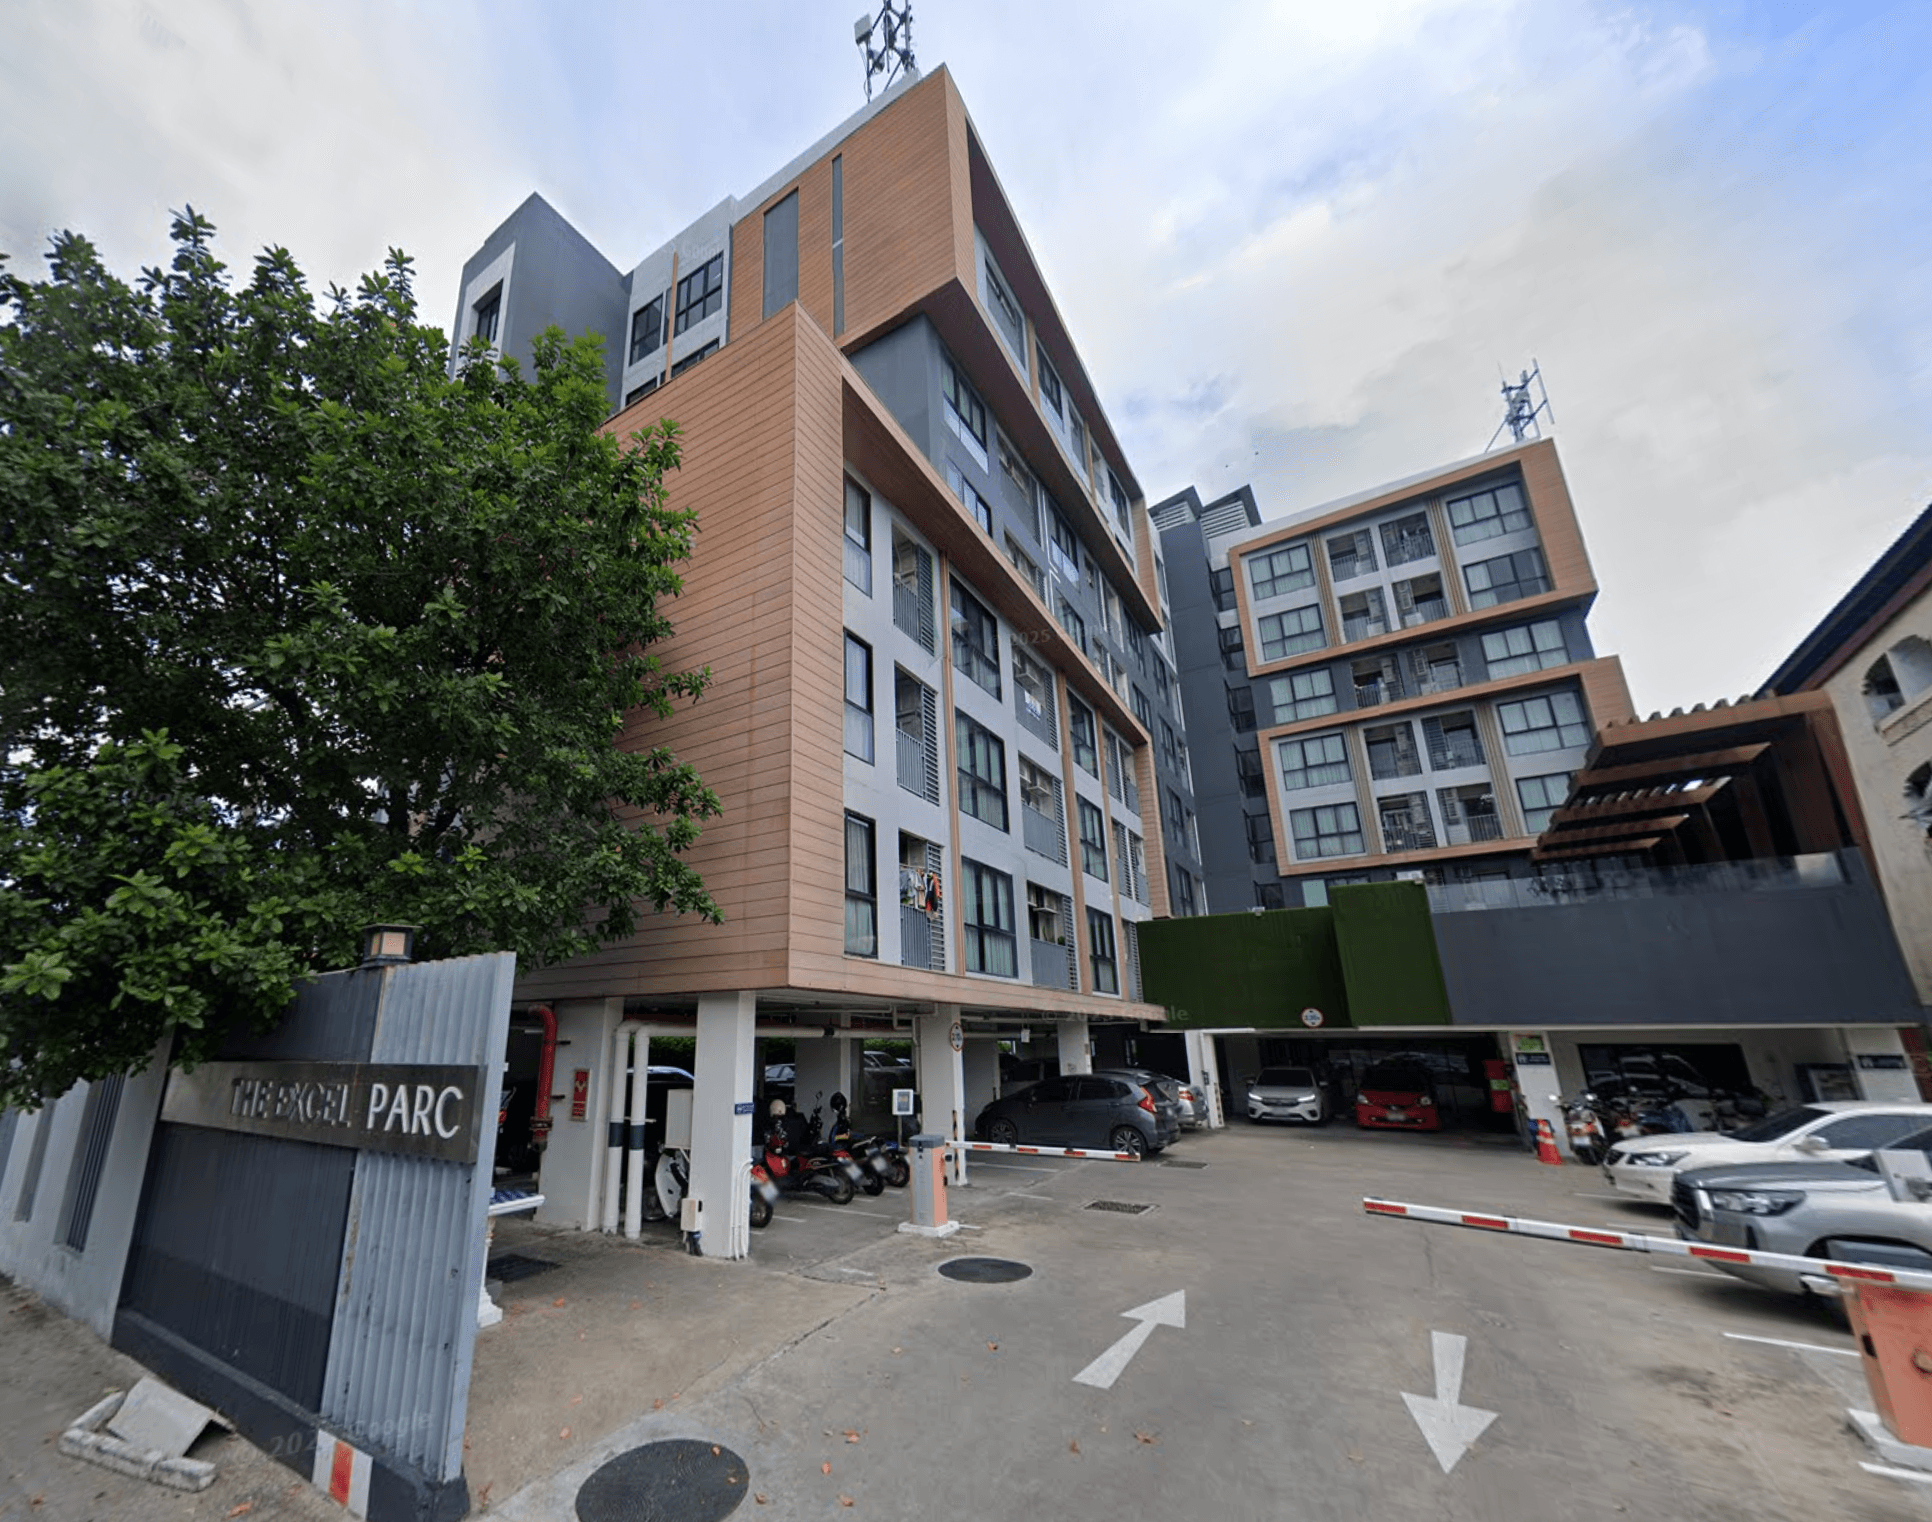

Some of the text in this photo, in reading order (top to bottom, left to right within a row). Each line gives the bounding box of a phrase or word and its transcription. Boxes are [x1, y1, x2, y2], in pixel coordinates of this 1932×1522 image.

[231, 1078, 464, 1139] THE EXCEL PARC
